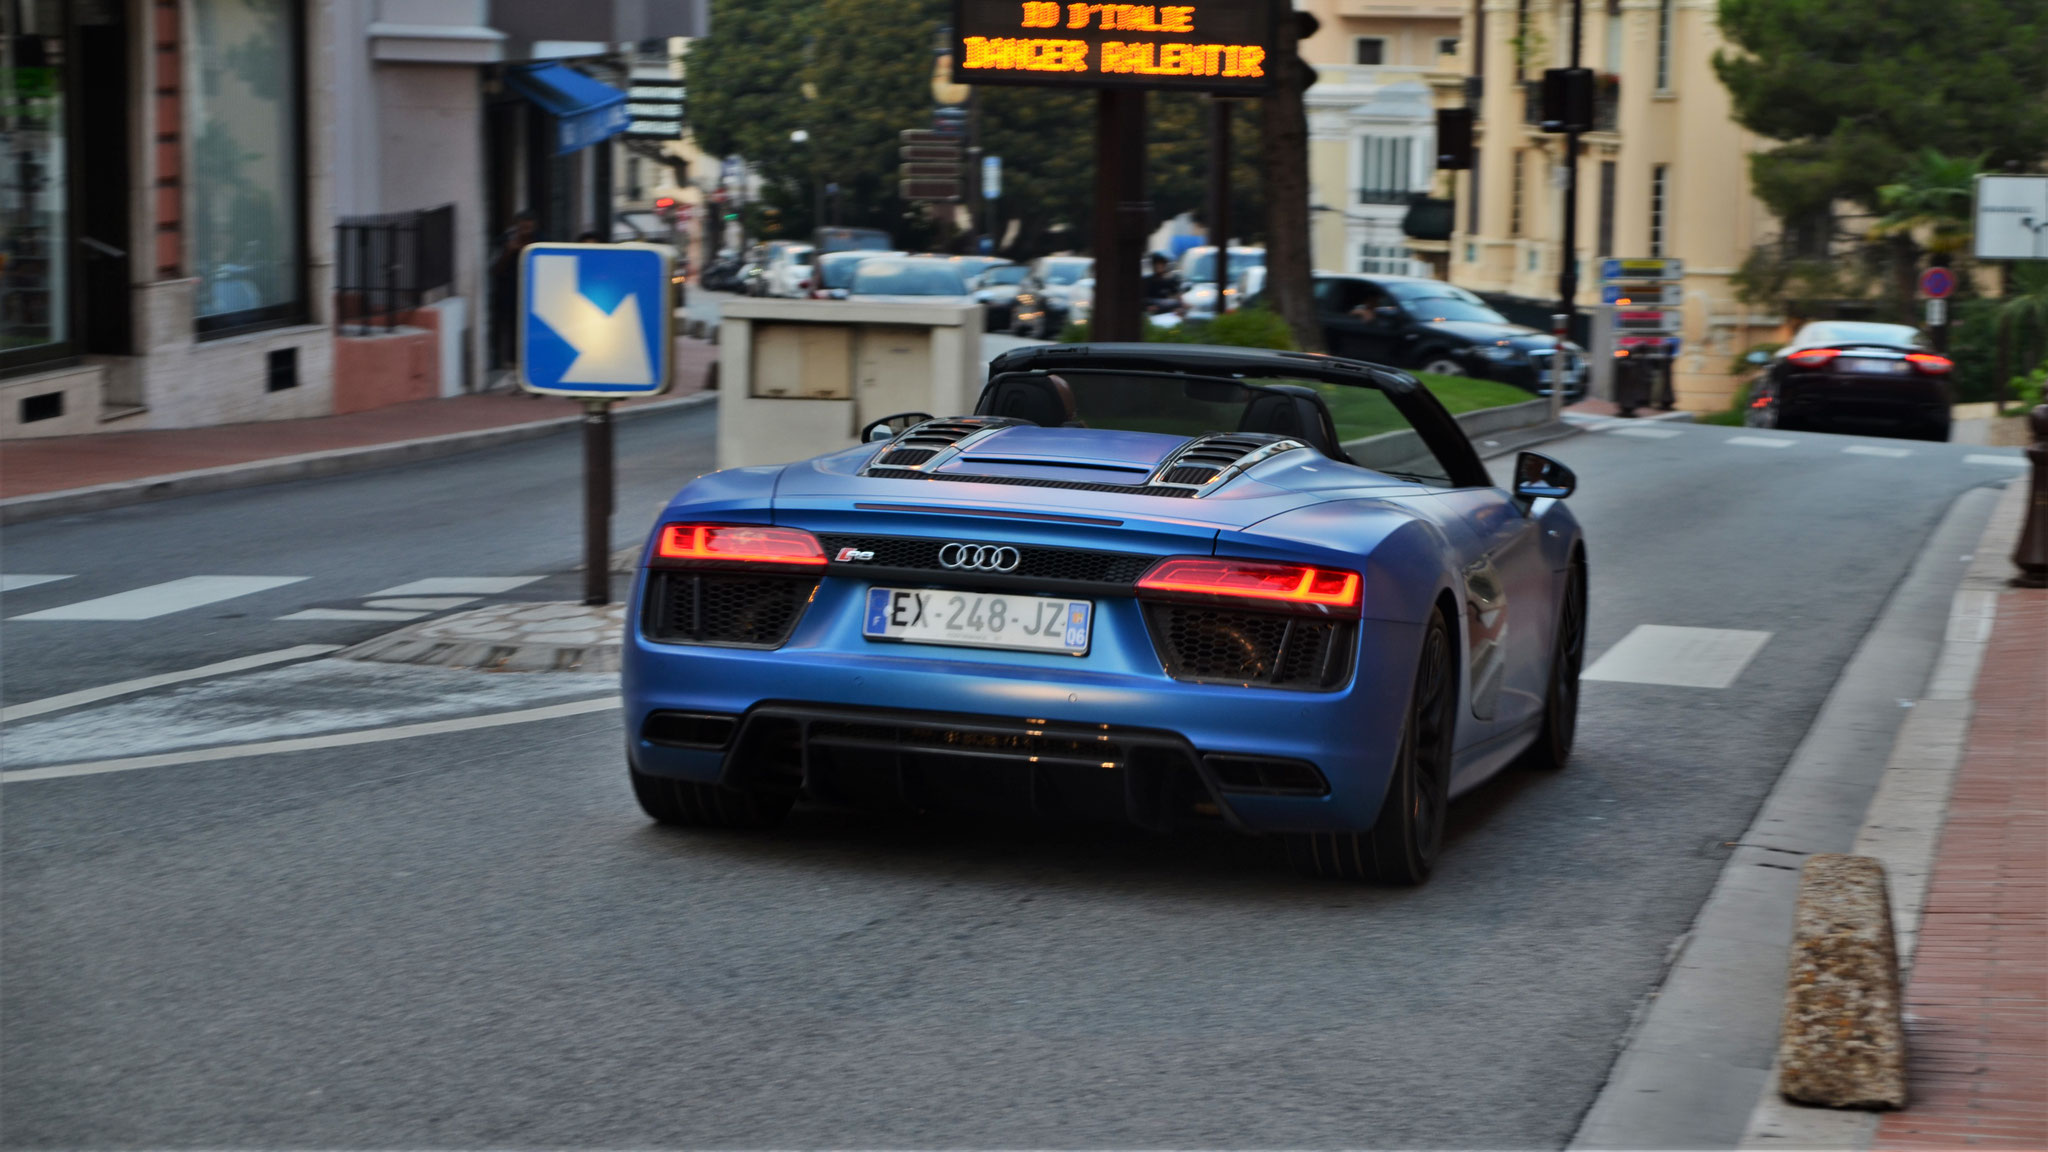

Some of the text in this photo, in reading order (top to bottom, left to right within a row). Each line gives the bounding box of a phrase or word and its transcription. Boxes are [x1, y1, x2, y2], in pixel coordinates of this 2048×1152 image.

[963, 36, 1265, 77] DANGER RALENTIR
[891, 591, 1065, 638] EX-248-JZ
[1066, 627, 1086, 646] 06
